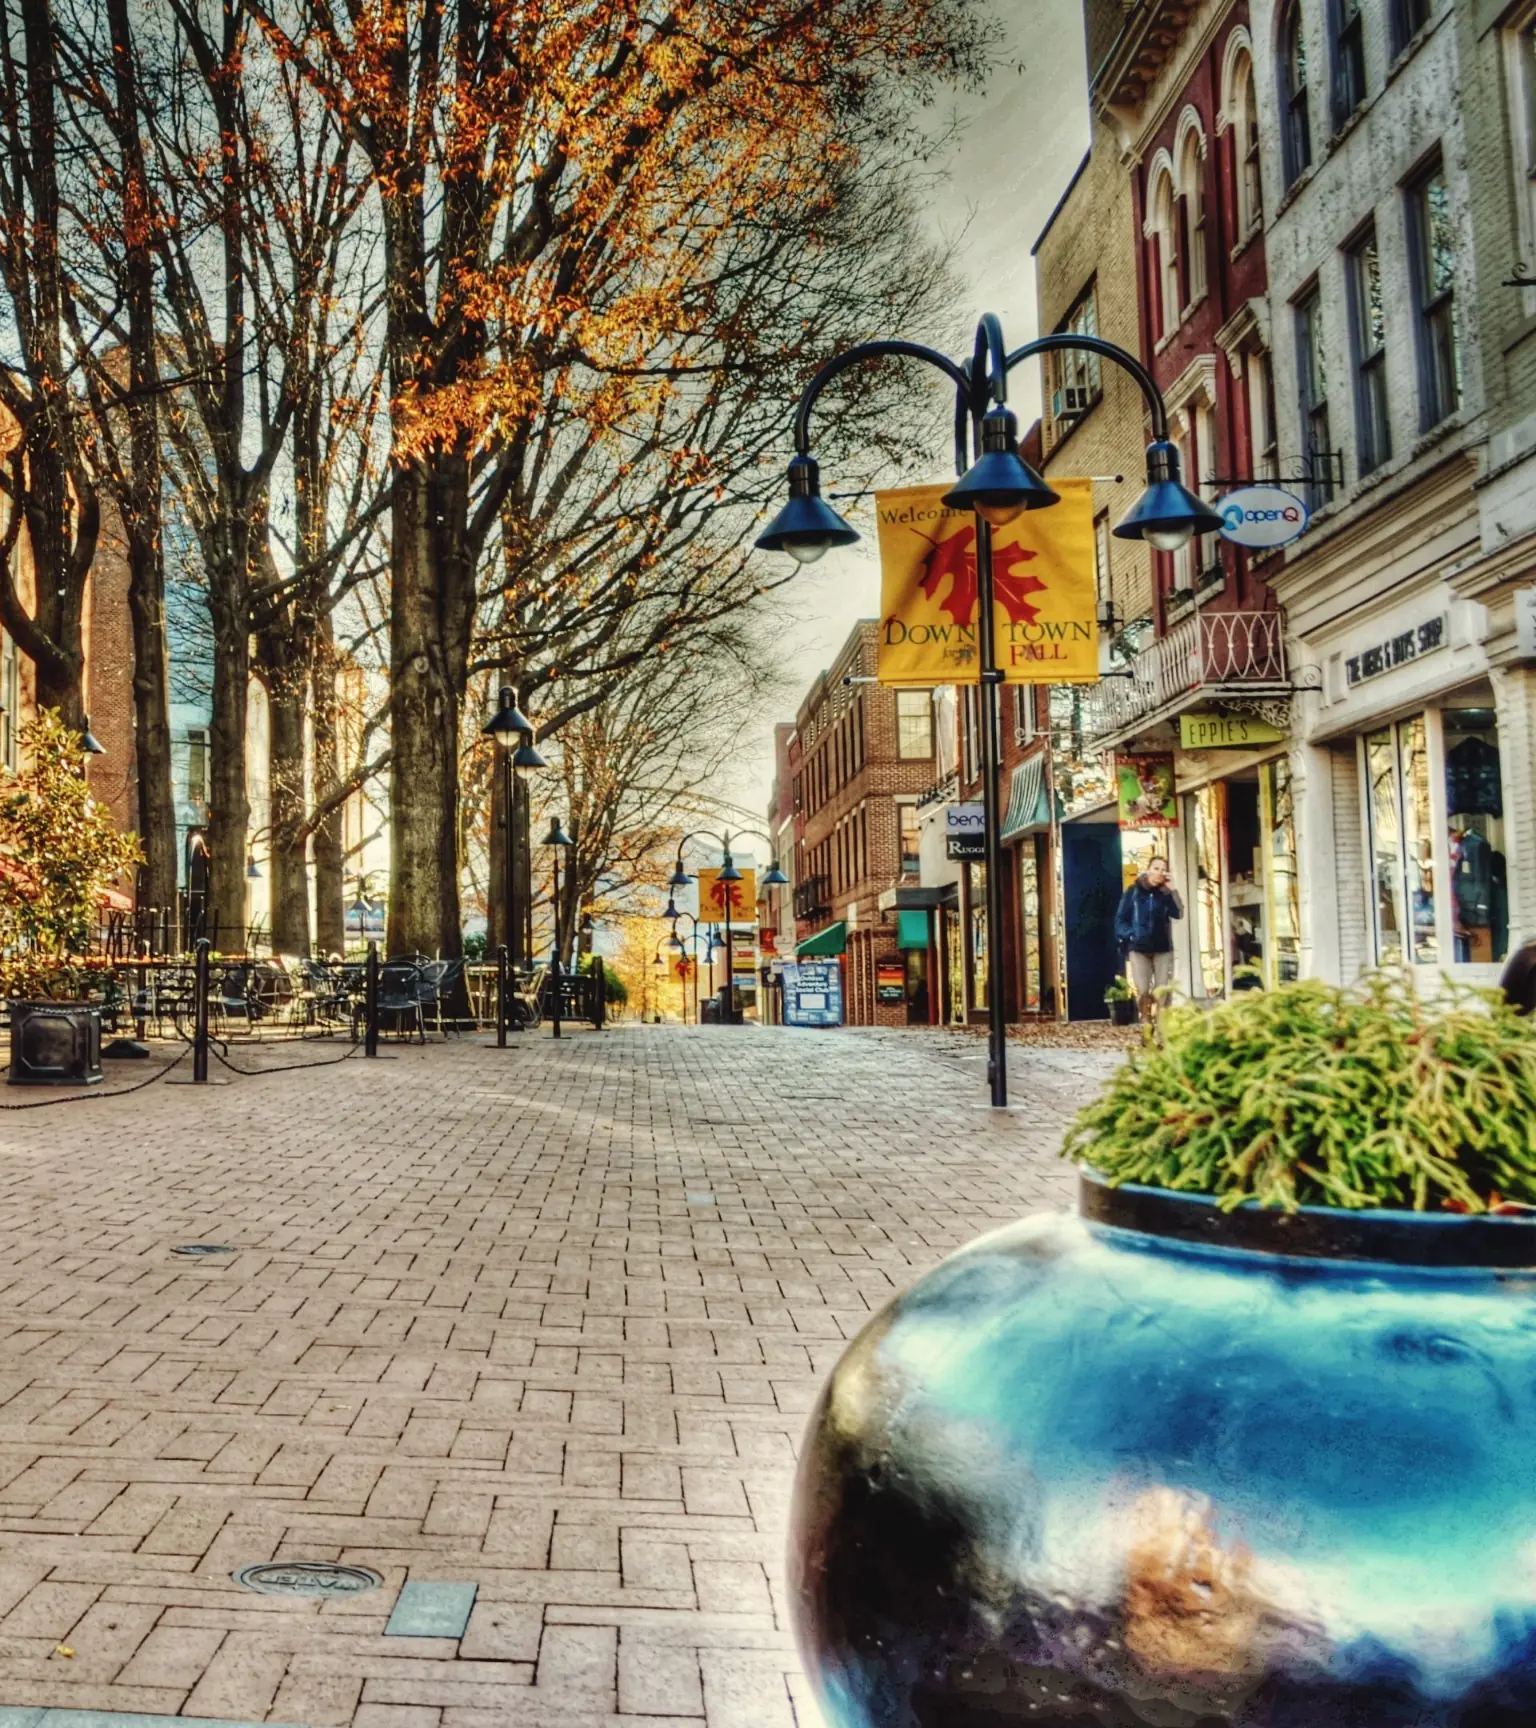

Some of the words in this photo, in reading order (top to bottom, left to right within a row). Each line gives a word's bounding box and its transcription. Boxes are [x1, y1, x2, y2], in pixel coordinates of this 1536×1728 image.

[880, 506, 968, 524] Welcome
[1245, 507, 1299, 523] openQ
[1011, 644, 1067, 666] FALL
[1189, 720, 1248, 744] EPPIE'S
